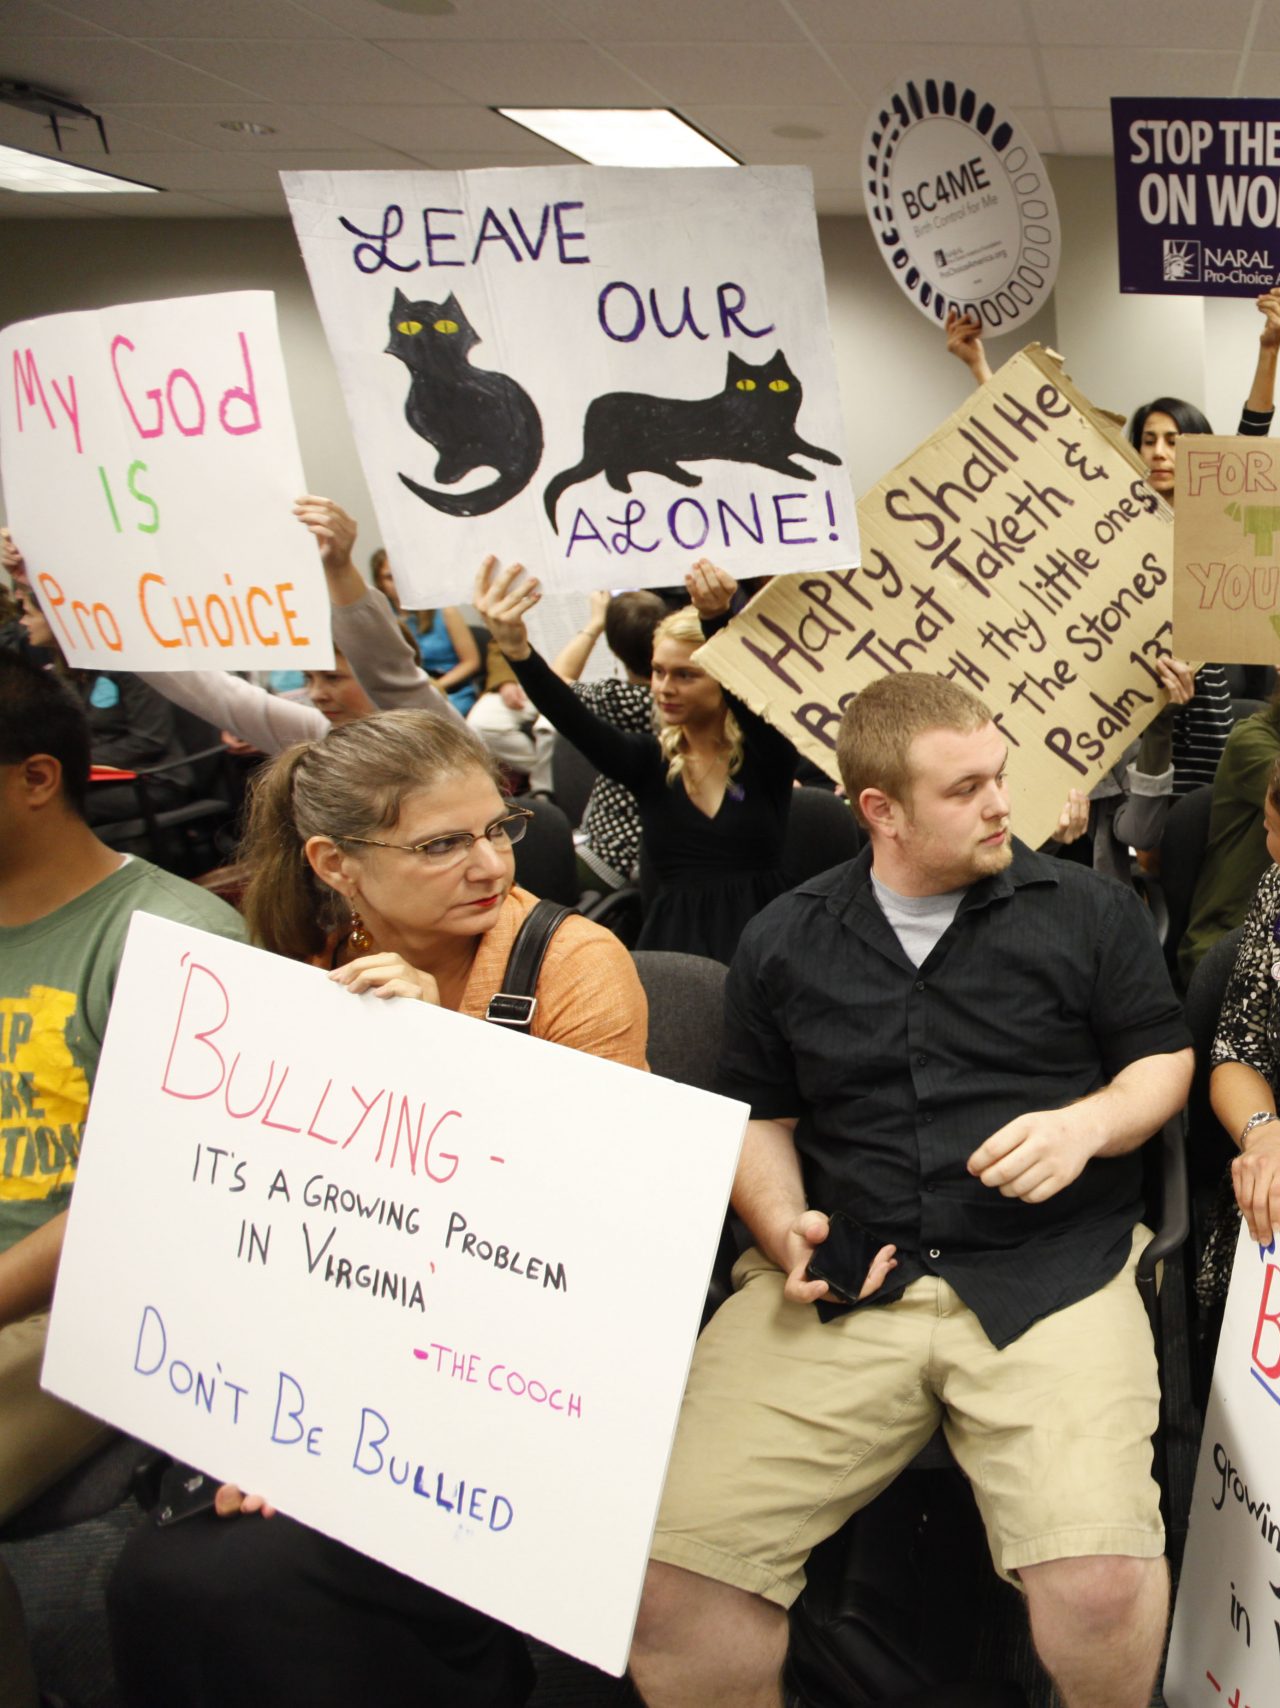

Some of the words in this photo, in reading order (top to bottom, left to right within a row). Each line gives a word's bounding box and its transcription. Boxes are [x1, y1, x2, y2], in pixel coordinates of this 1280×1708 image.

[1129, 120, 1214, 164] STOP
[902, 157, 990, 219] BC4ME
[1140, 173, 1197, 225] ON
[339, 202, 591, 274] LEAVE
[1203, 248, 1274, 269] NARAL
[1203, 268, 1274, 286] Pro-Choice
[599, 282, 776, 342] OUR
[13, 347, 84, 455] My
[98, 460, 160, 534] IS
[886, 416, 1019, 550] Shall
[994, 384, 1072, 442] He
[1187, 451, 1278, 497] FOR
[566, 490, 840, 557] ALONE!
[847, 586, 956, 673] That
[932, 480, 1075, 597] Taketh
[1057, 437, 1109, 481] &
[980, 608, 1047, 662] thy
[1019, 547, 1100, 616] little
[1094, 479, 1159, 544] ones
[1186, 562, 1280, 611] YOU
[38, 573, 123, 652] Pro
[1010, 659, 1079, 714] the
[1066, 552, 1167, 662] Stones
[1045, 689, 1154, 775] Psalm
[192, 1144, 248, 1194] IT'S
[268, 1169, 290, 1203] A
[302, 1175, 420, 1235] GROWING
[445, 1212, 568, 1293] PROBLEM
[237, 1219, 272, 1266] IN
[134, 1306, 249, 1425] DON'T
[352, 1408, 515, 1533] BULLIED
[488, 1365, 583, 1420] COOCH
[1231, 1581, 1251, 1648] in
